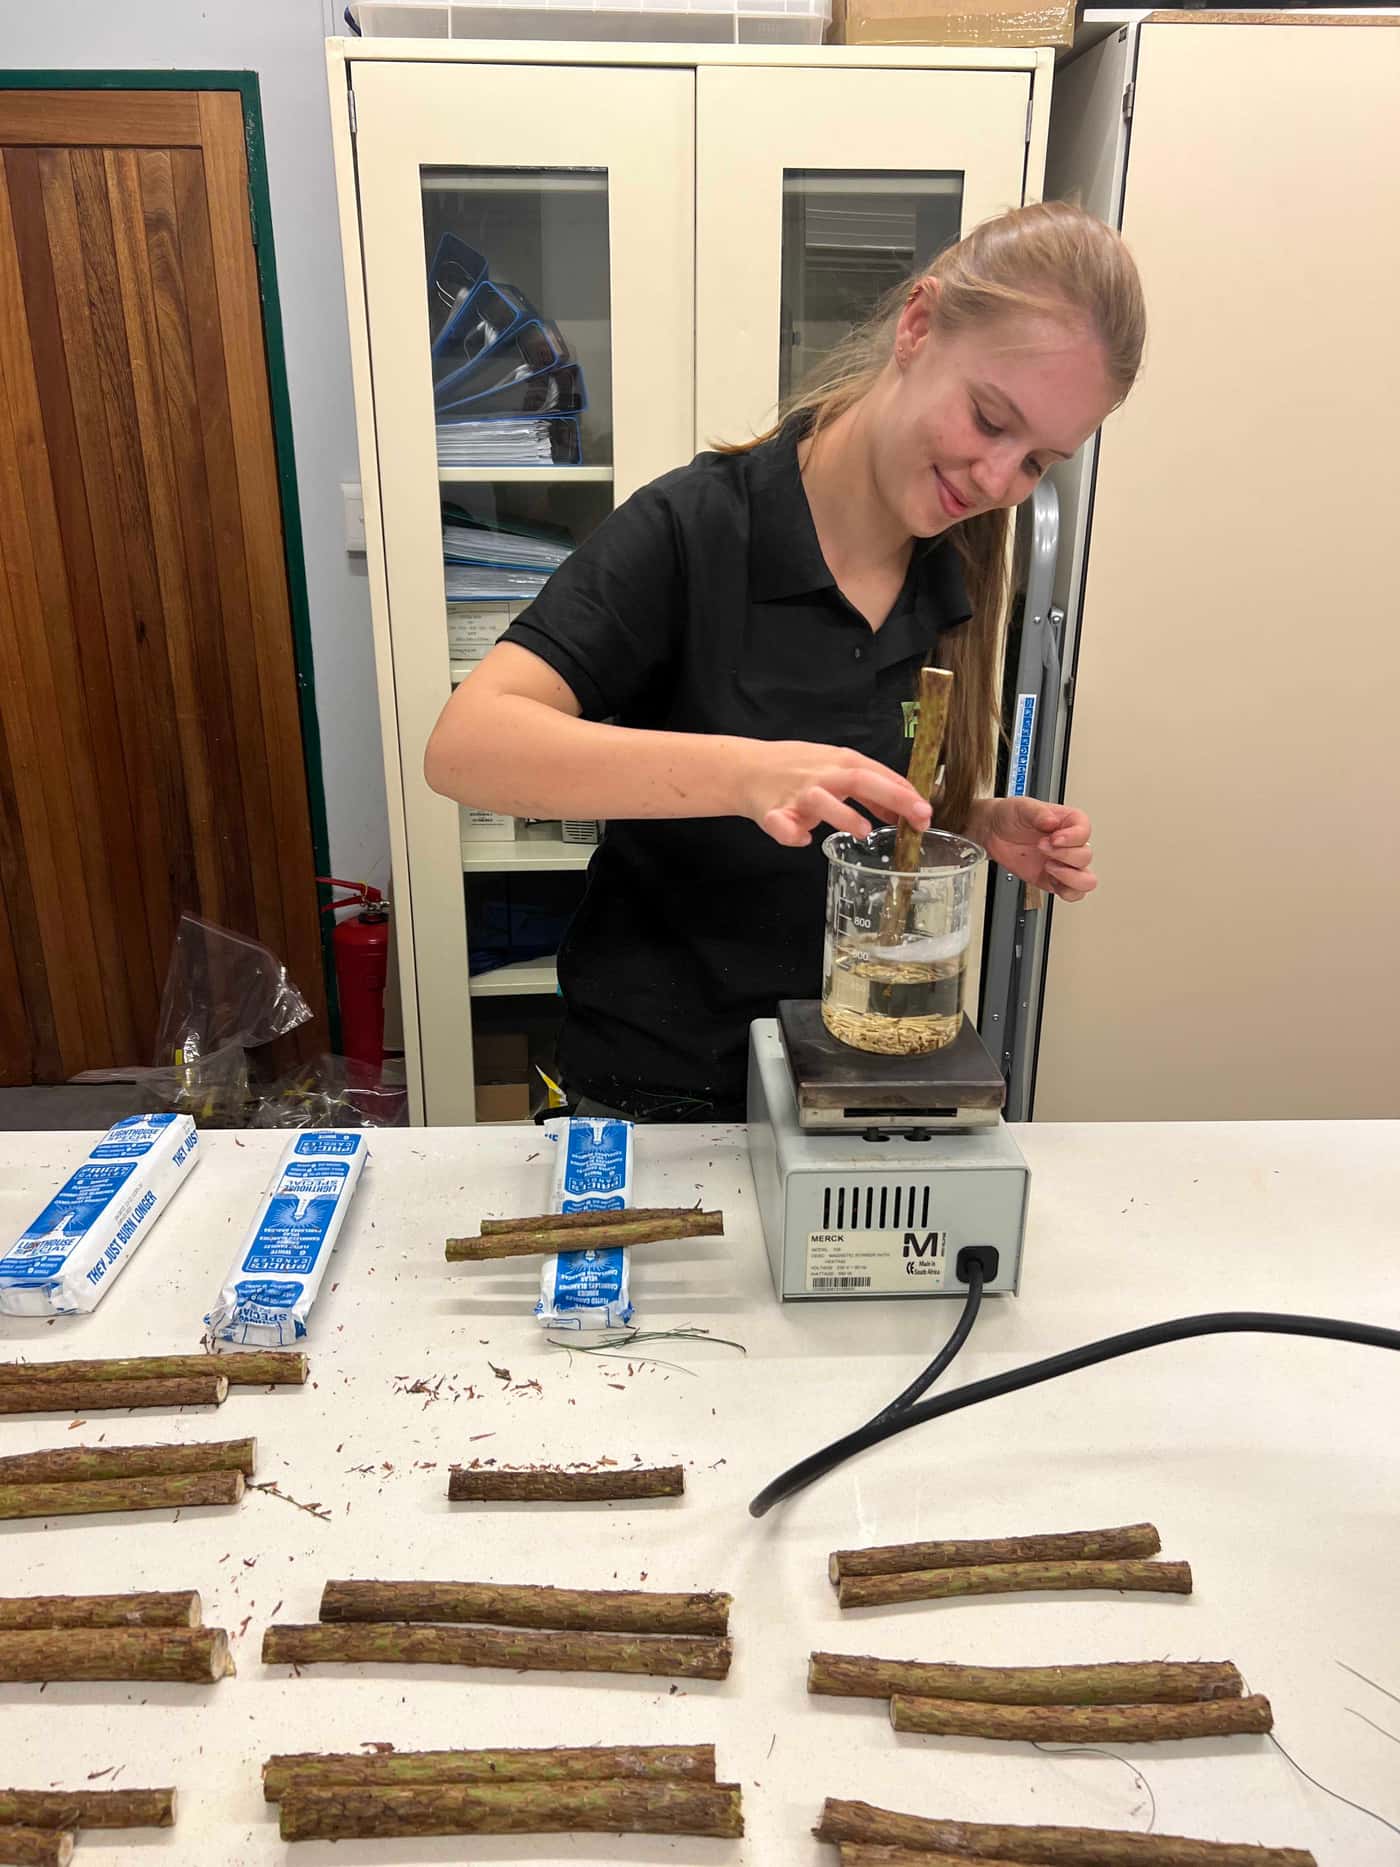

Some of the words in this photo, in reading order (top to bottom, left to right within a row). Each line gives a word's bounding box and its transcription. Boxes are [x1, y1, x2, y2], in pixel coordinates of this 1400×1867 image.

[171, 1148, 188, 1168] THEY
[185, 1129, 199, 1152] JUST
[86, 1260, 109, 1286] THEY
[104, 1239, 124, 1266] JUST
[117, 1216, 137, 1242] BURN
[132, 1190, 158, 1225] LONGER
